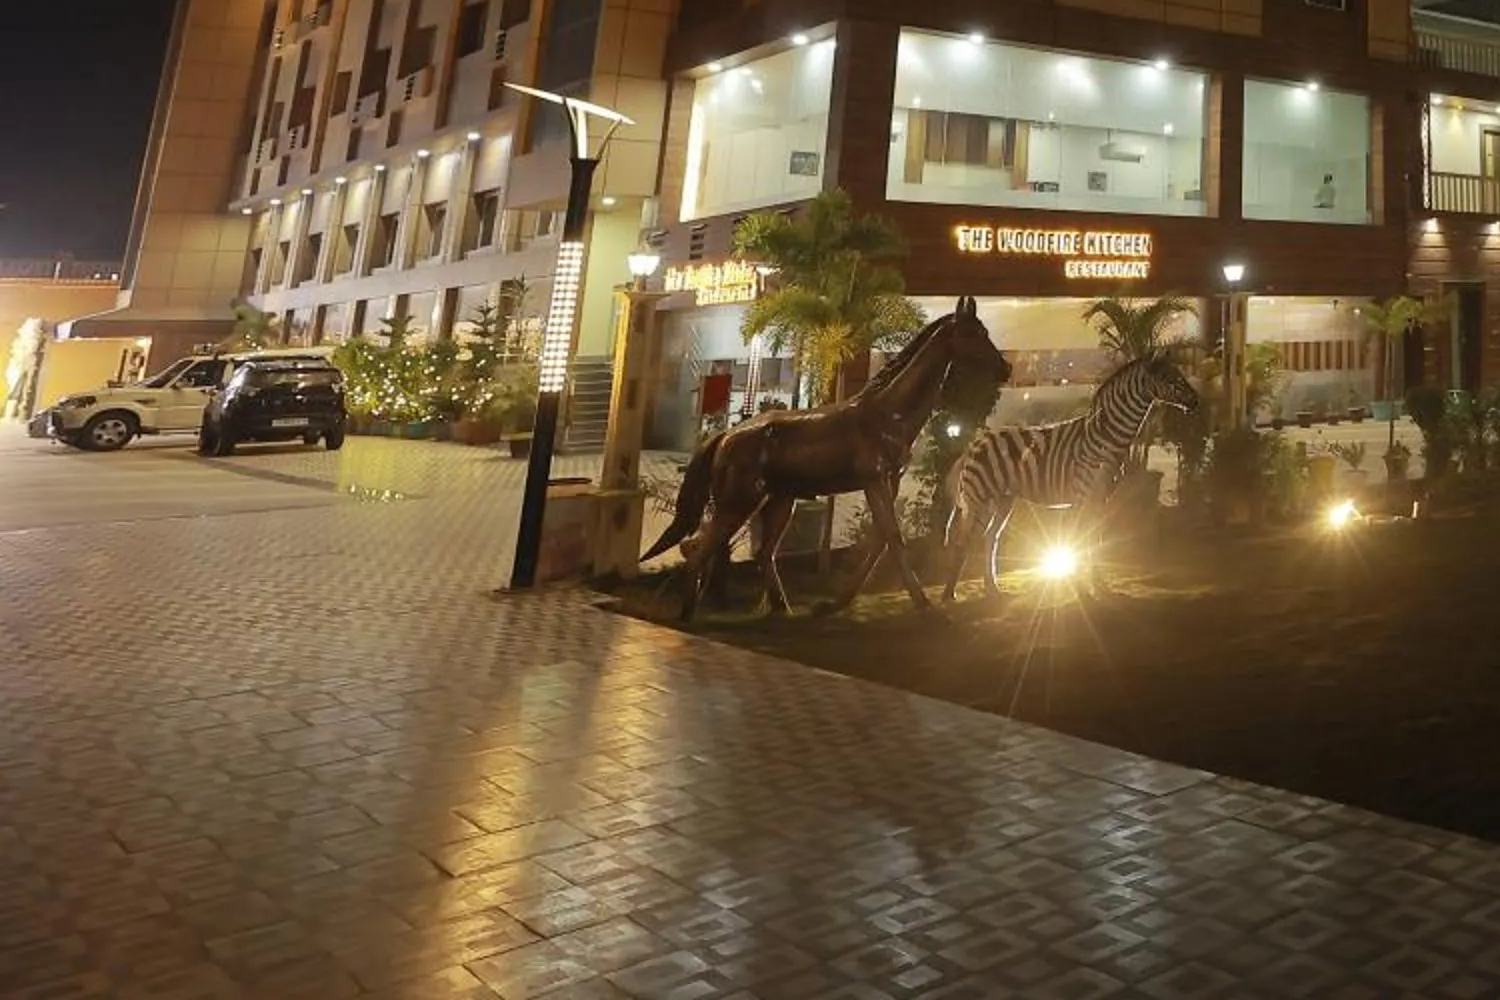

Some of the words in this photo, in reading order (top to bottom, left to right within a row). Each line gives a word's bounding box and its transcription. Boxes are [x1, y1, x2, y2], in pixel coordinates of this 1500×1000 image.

[957, 226, 994, 252] THE
[998, 228, 1081, 255] WOODFIRE
[1084, 231, 1152, 257] KITCHEN
[1065, 260, 1150, 279] RESTAURANT
